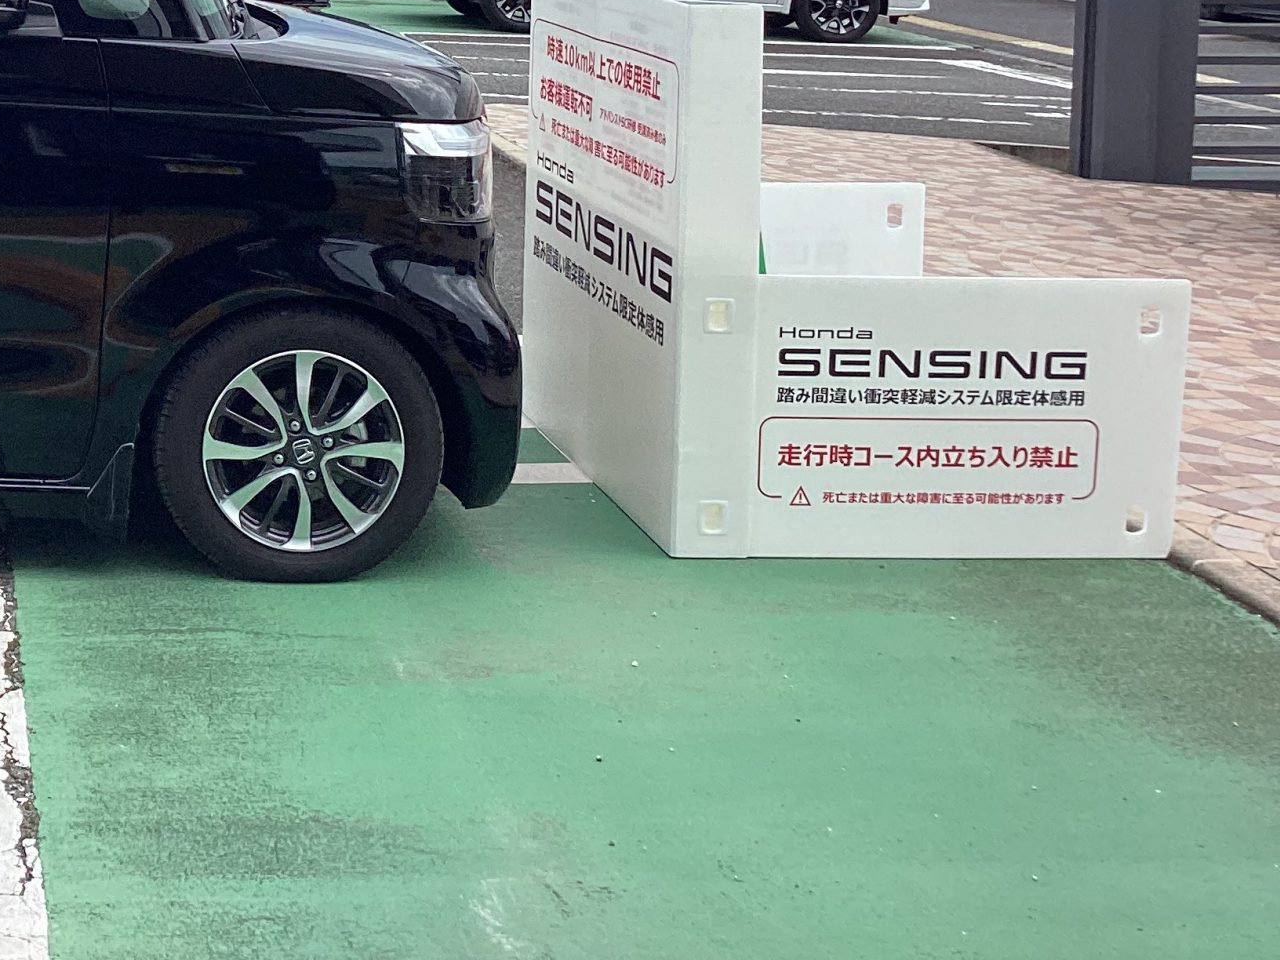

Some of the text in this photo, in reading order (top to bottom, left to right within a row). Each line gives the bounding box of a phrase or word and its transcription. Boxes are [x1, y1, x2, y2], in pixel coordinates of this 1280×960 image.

[546, 35, 661, 101] 時速10km以上での使用禁止
[539, 76, 593, 122] お客様運転不可
[537, 150, 574, 184] Honda
[536, 179, 673, 304] SENSING
[779, 327, 873, 340] Honda
[777, 348, 1088, 380] SENSING
[776, 387, 1085, 407] 踏み間違い衝突軽減システム限定体感用
[777, 444, 1079, 468] 走行時コース内立ち入り禁止
[822, 492, 1065, 505] 死亡または重大な障害に至る可能性があります
